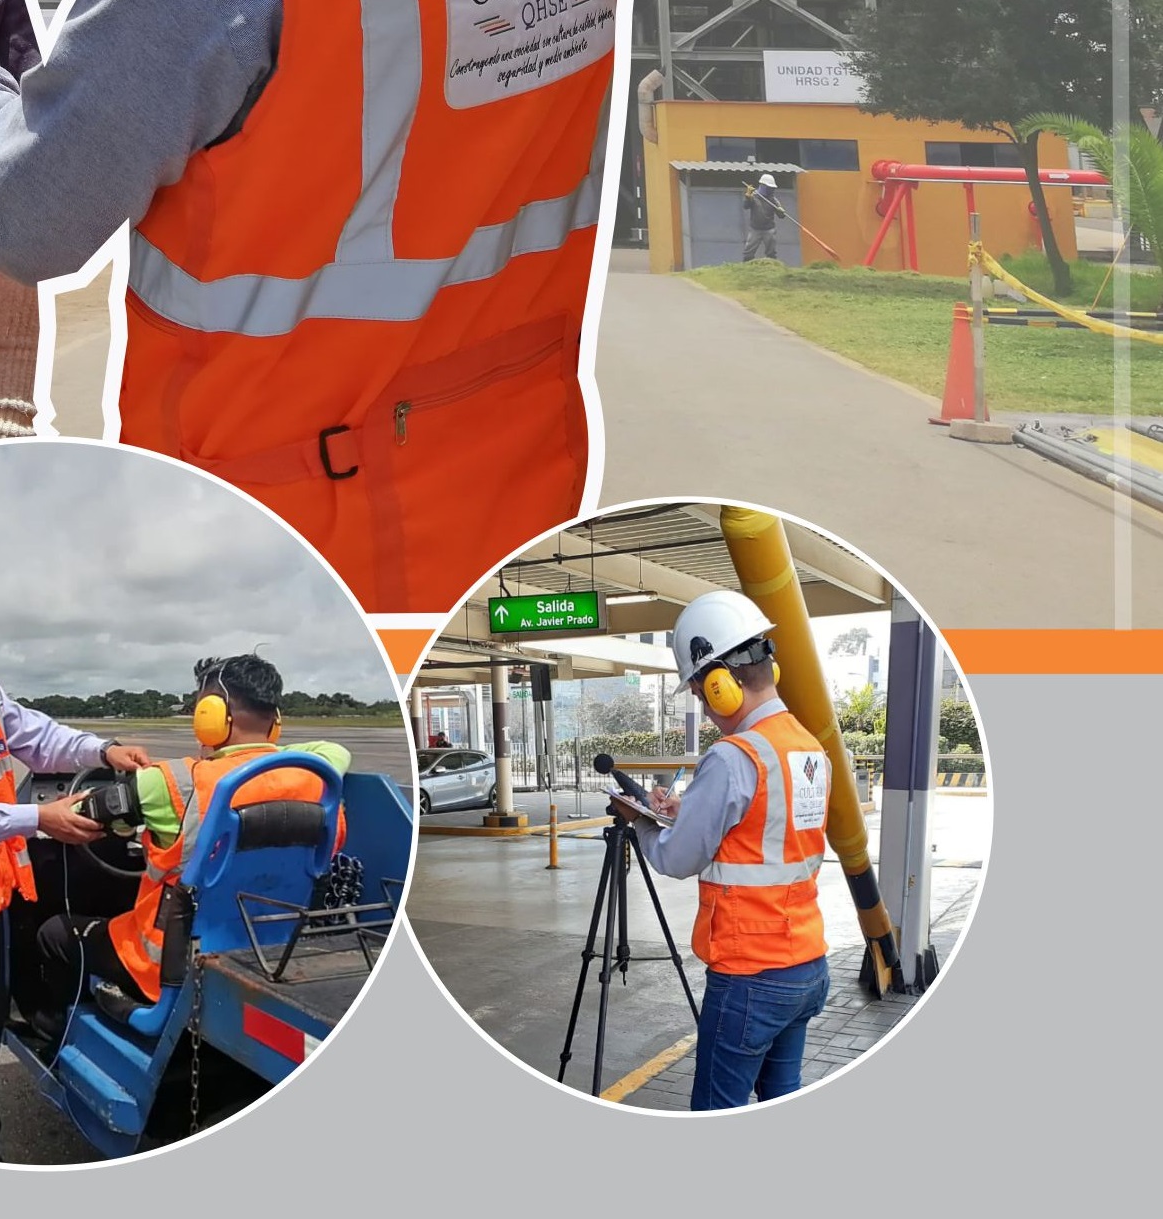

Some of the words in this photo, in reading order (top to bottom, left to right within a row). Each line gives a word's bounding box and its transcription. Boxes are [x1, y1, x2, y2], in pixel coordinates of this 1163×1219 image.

[497, 53, 539, 88] seguridad
[544, 46, 563, 67] medio
[562, 36, 589, 60] ambiente
[777, 65, 823, 76] UNIDAD
[795, 77, 829, 86] HRSG
[833, 77, 840, 86] 2
[536, 600, 575, 614] Salida
[520, 618, 534, 628] Av.
[536, 616, 565, 627] Javier
[566, 614, 594, 625] Prado
